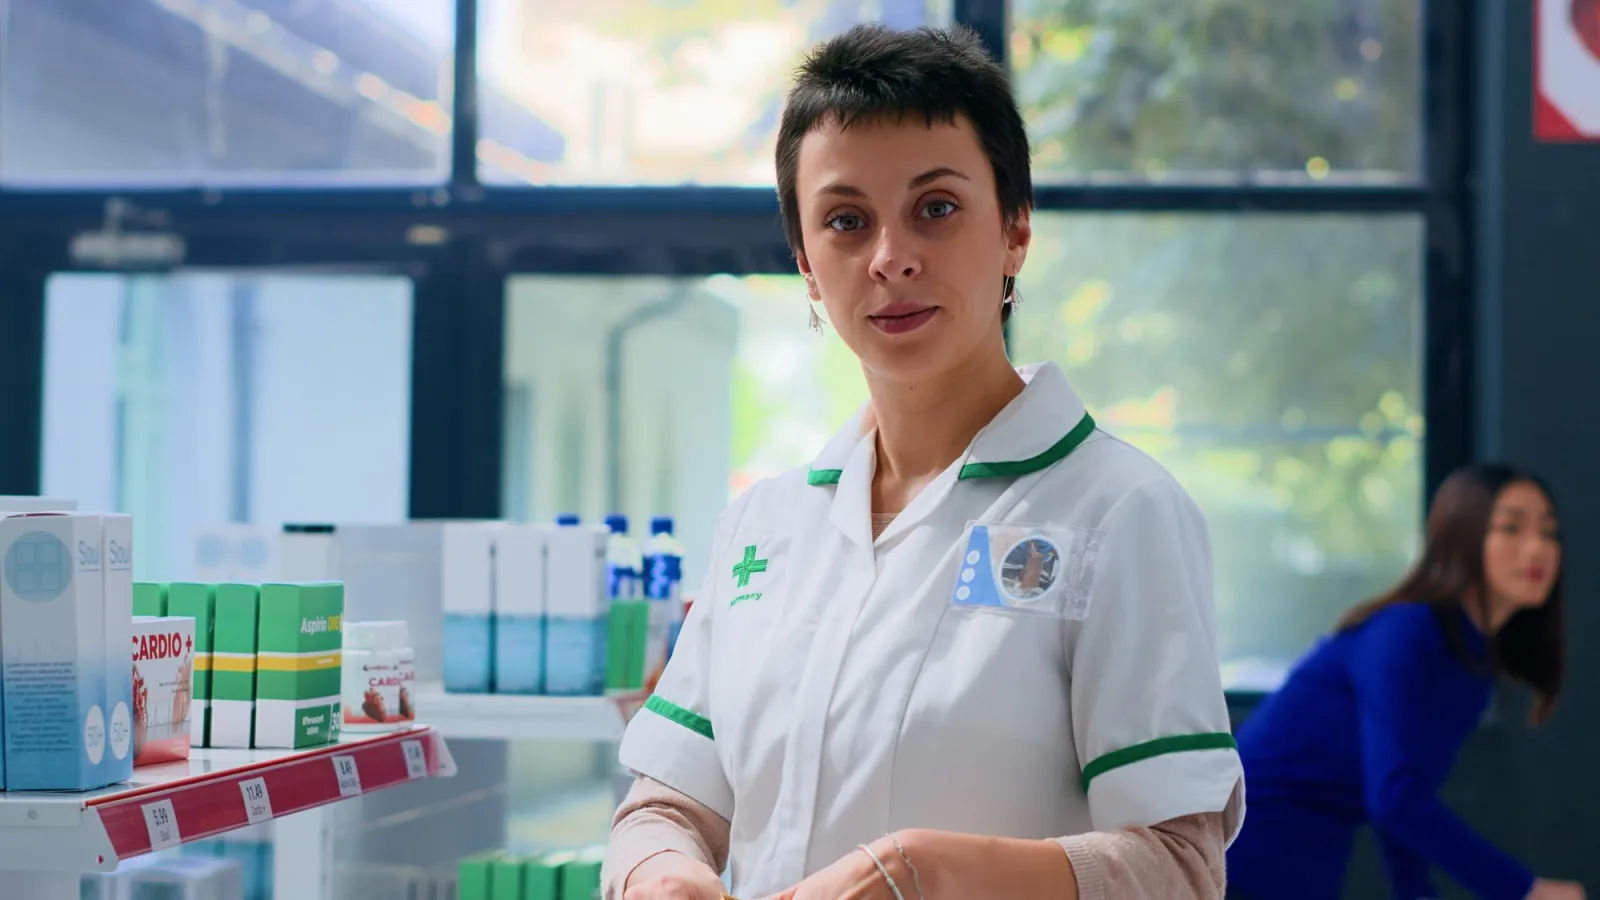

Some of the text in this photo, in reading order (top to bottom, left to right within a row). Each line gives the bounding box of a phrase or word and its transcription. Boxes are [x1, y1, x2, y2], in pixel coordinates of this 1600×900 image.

[79, 540, 100, 565] Soul
[109, 540, 131, 564] Soul
[300, 616, 327, 636] Aspirin
[132, 632, 182, 661] CARDIO
[246, 783, 263, 801] 11.49
[152, 807, 168, 825] 5.99
